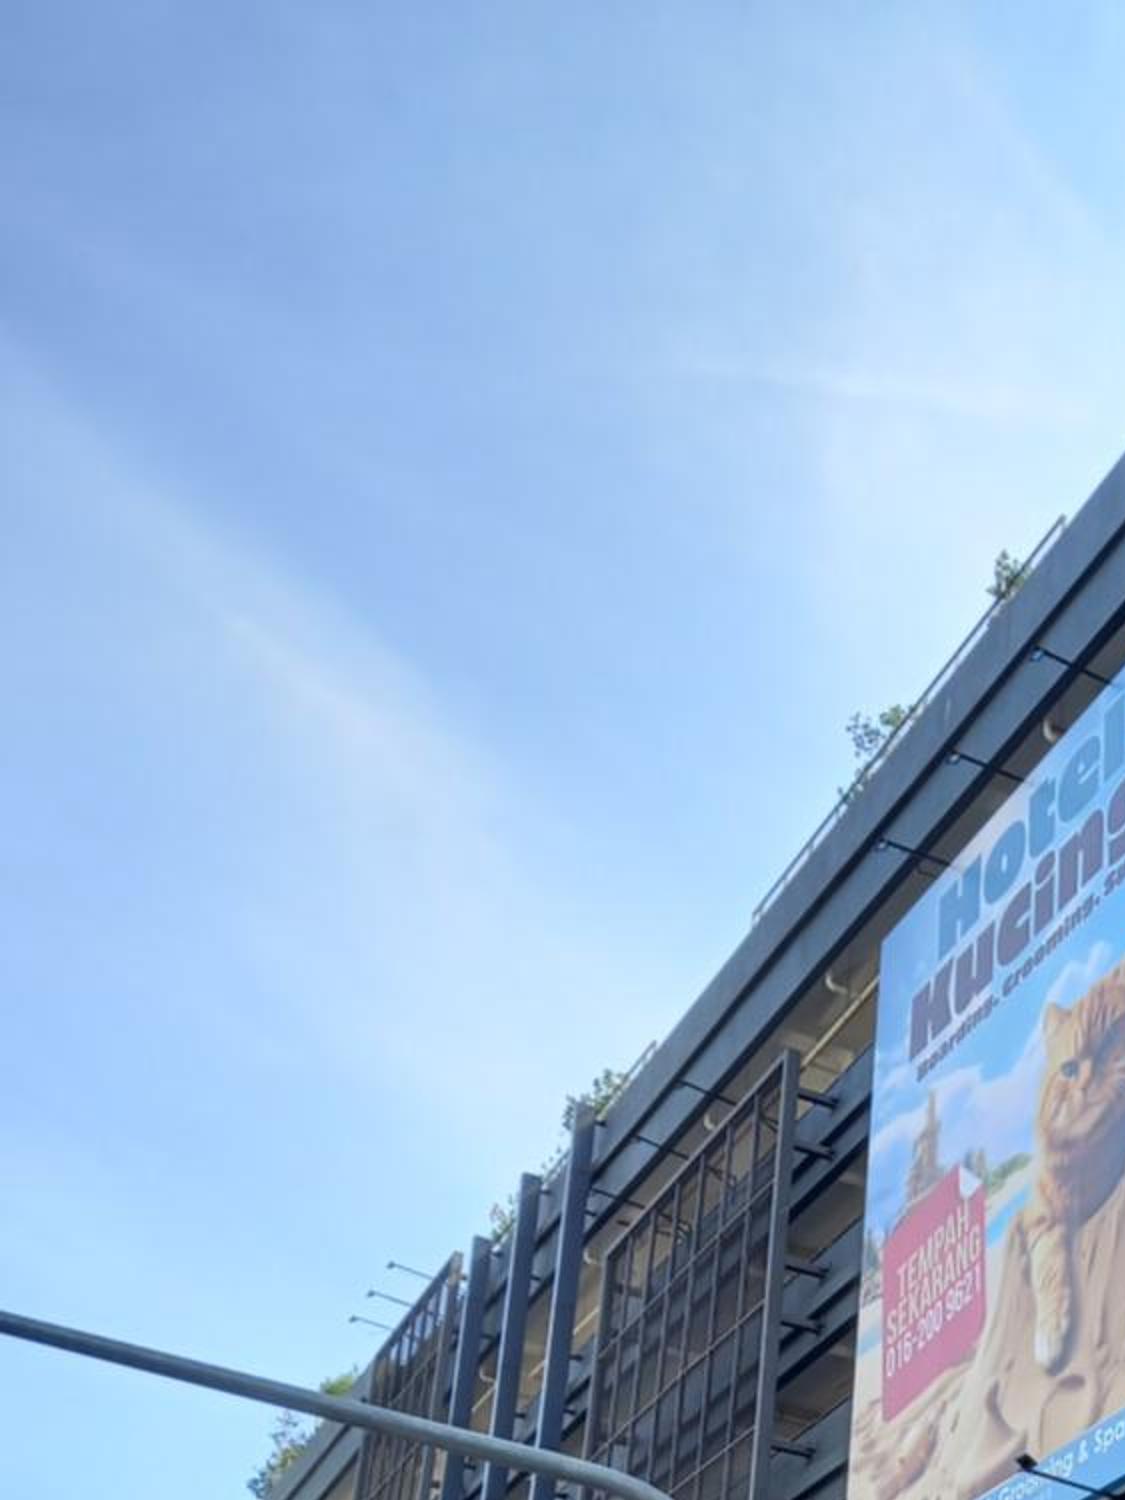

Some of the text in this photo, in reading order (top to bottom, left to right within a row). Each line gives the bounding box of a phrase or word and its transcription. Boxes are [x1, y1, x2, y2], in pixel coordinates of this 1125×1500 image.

[938, 689, 1125, 962] Hotel
[886, 1223, 981, 1346] SEKARANG
[897, 1198, 969, 1300] TEMPAH
